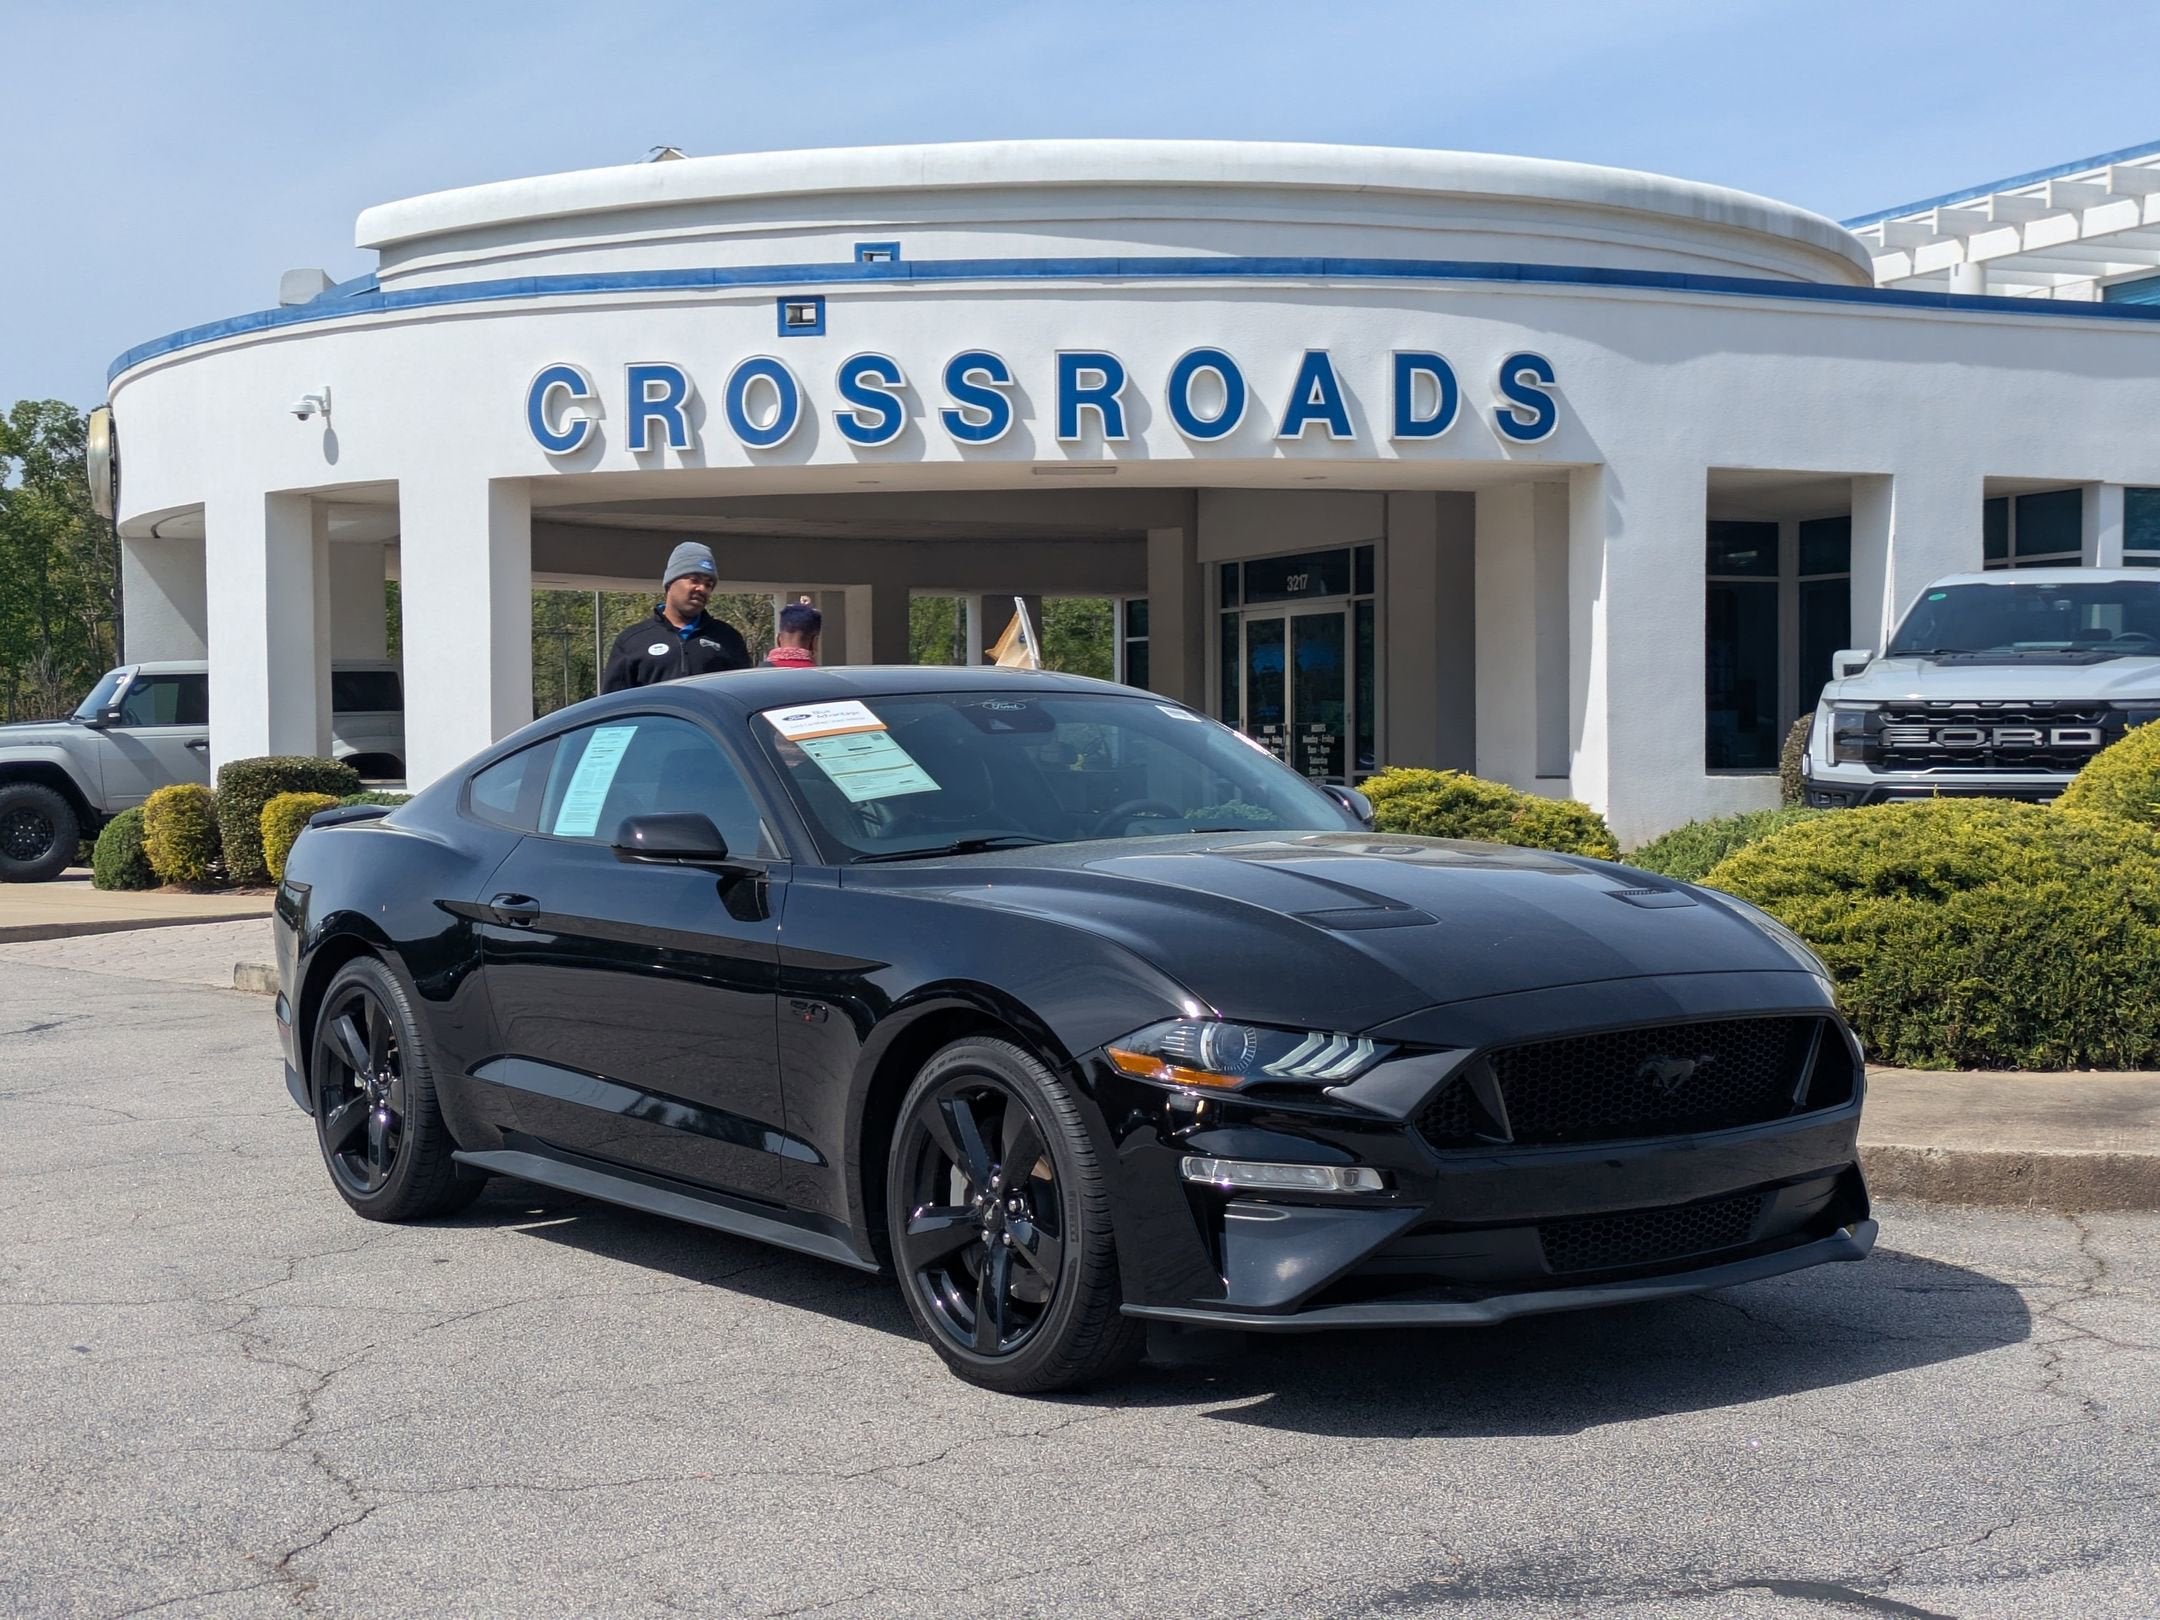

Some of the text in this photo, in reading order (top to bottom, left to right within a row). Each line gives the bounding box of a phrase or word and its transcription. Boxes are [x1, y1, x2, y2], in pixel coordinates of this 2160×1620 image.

[525, 346, 1559, 456] CROSSROADS
[1286, 574, 1309, 592] 3217
[1880, 727, 2102, 746] FORD
